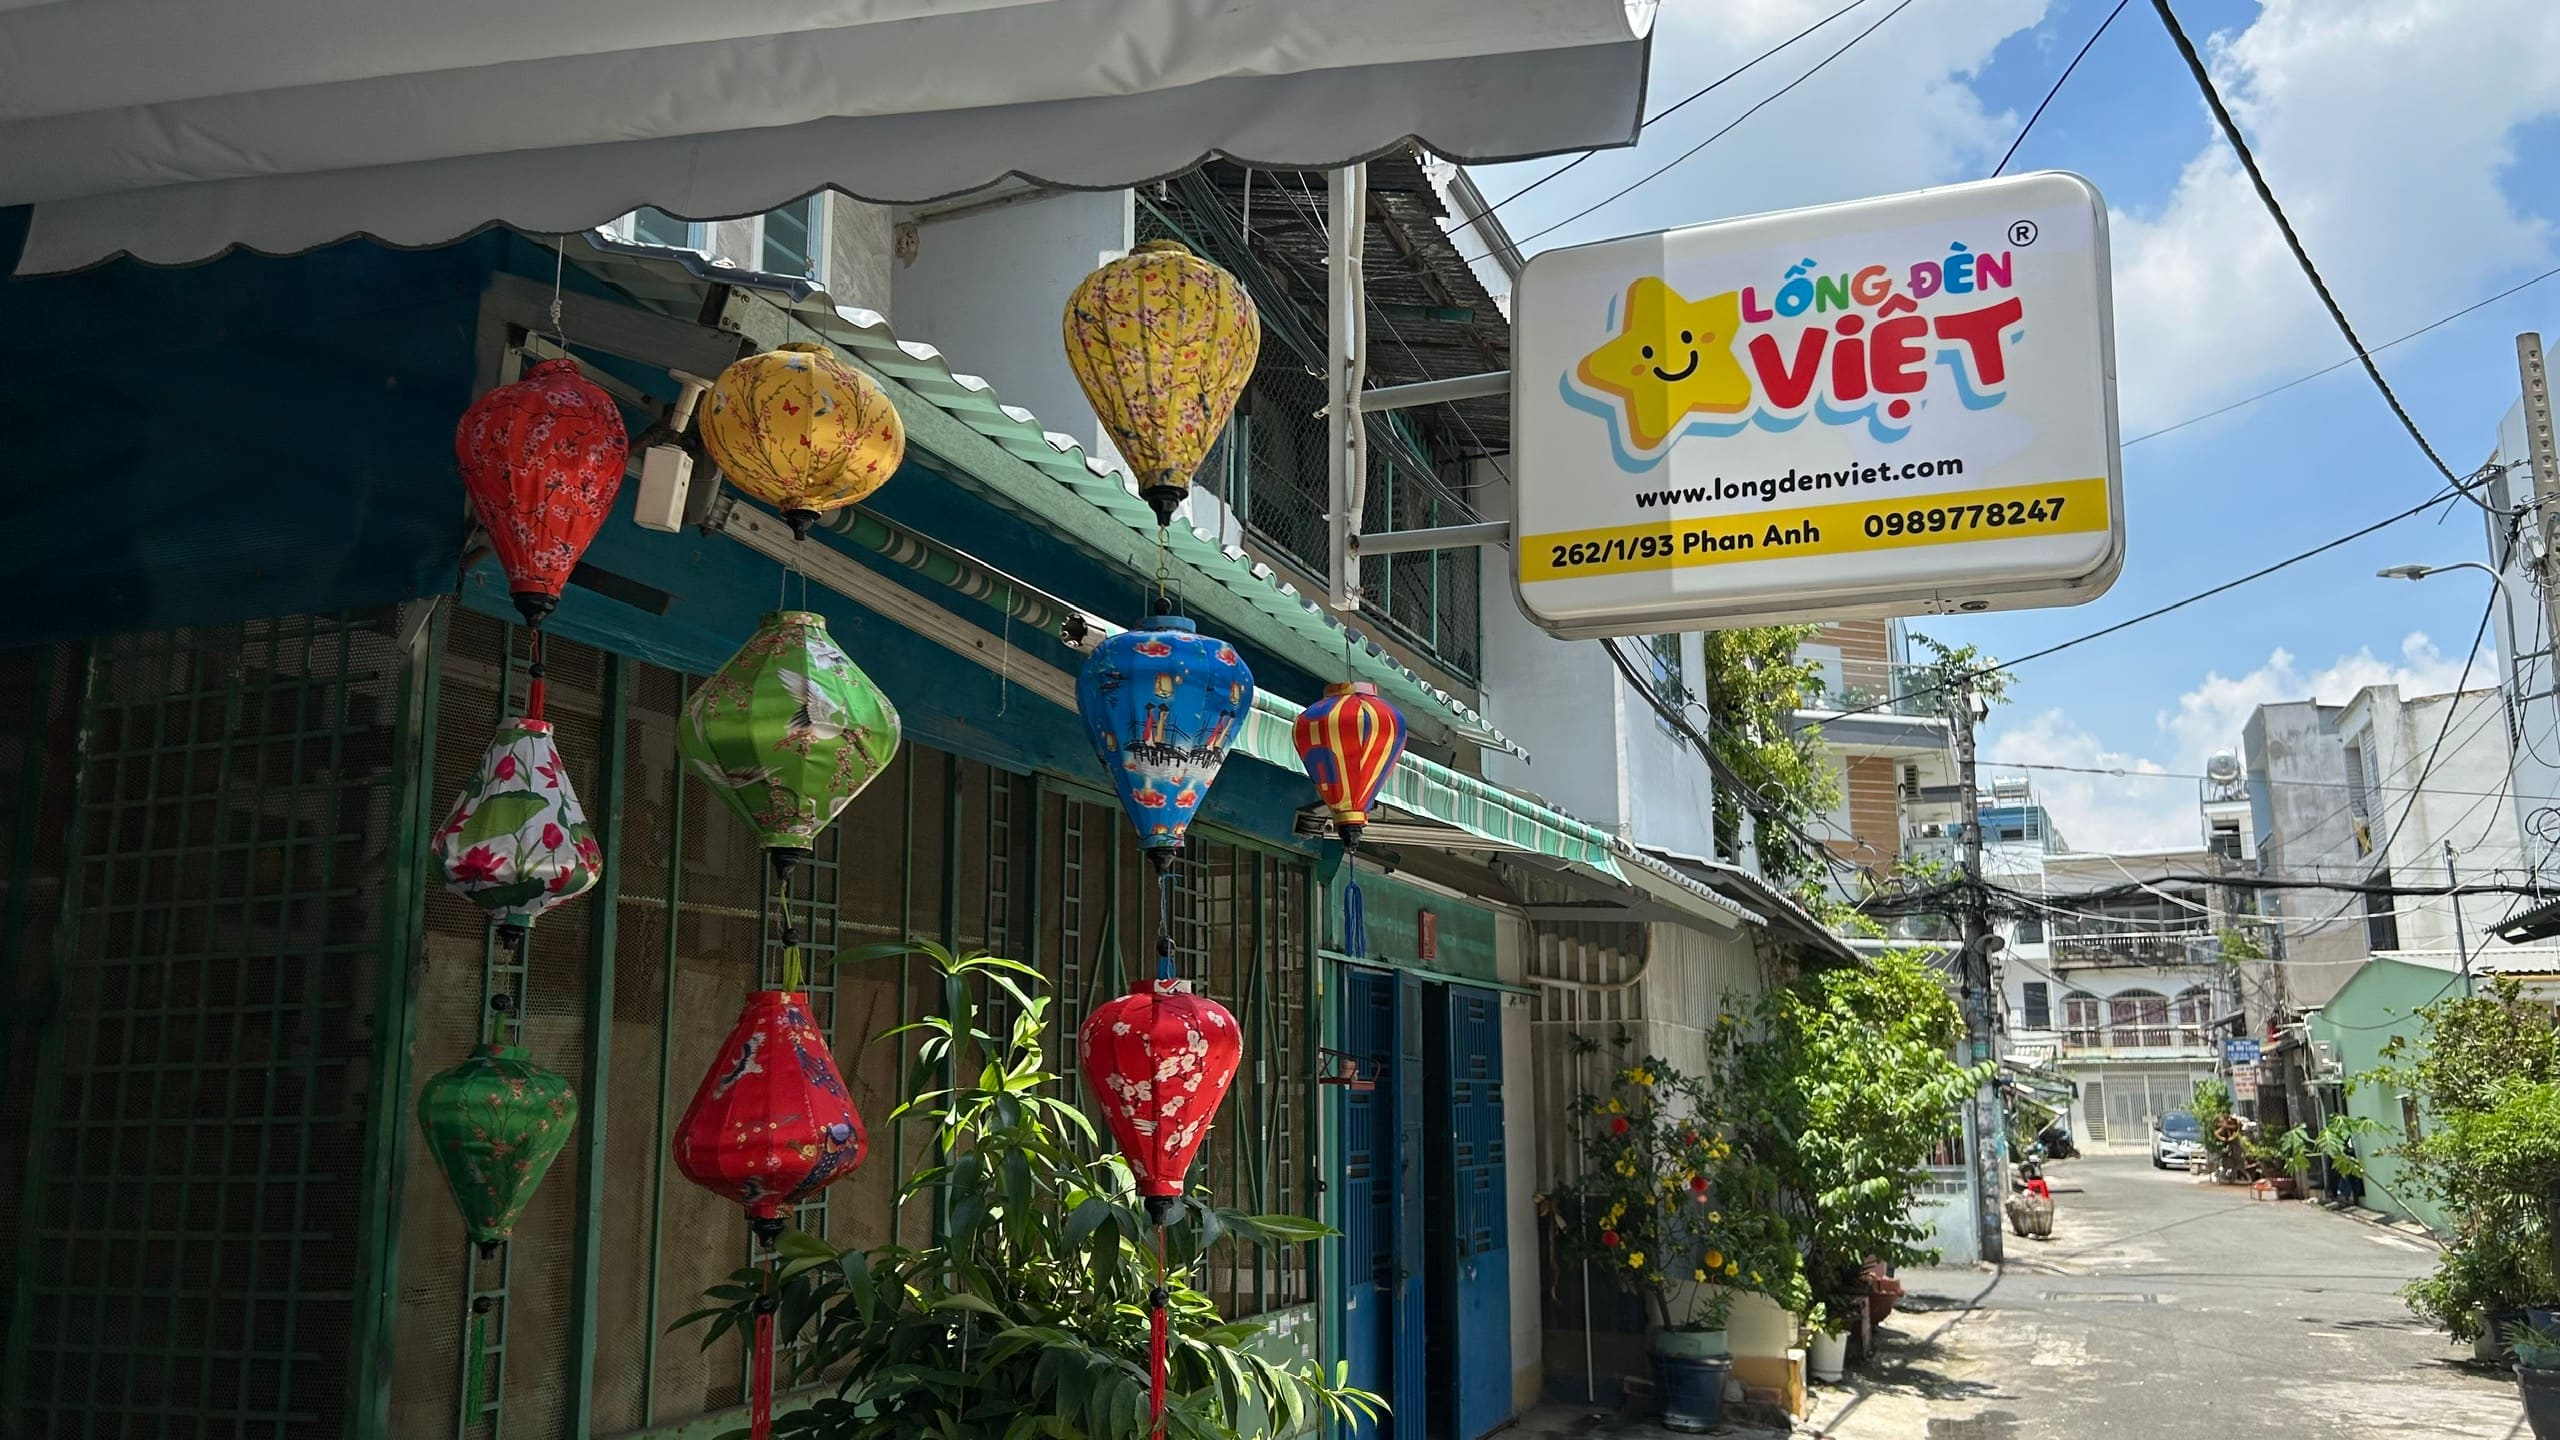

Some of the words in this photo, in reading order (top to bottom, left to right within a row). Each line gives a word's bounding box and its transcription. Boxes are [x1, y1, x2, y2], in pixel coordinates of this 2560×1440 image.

[1741, 258, 1892, 323] LỒNG
[1907, 241, 2012, 299] ĐÈN
[1635, 458, 1963, 508] www.longdenviet.com
[1551, 534, 1674, 568] 262/1/93
[1683, 530, 1753, 554] Phan
[1762, 519, 1820, 547] Anh
[1864, 497, 2065, 537] 0989778247
